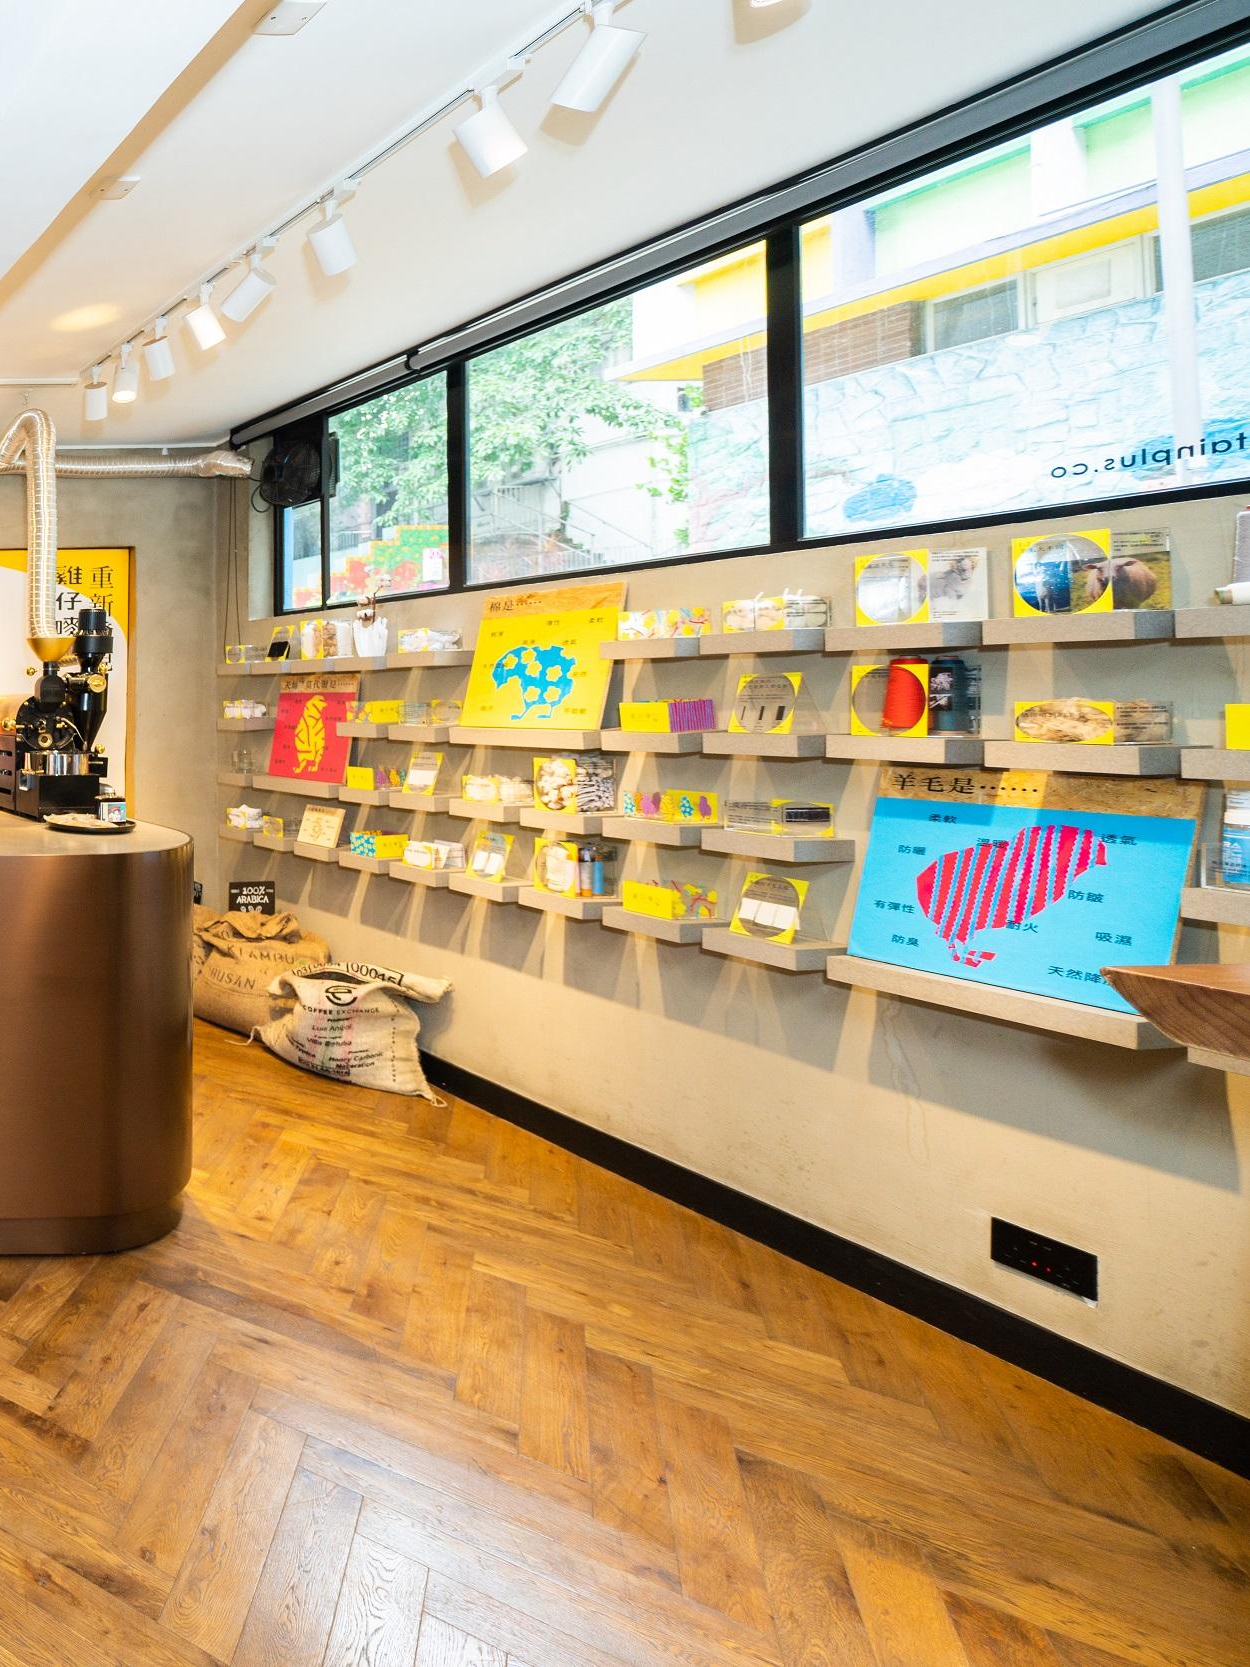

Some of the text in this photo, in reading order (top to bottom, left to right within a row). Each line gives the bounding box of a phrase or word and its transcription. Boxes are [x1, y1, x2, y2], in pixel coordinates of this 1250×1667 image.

[928, 813, 957, 824] 柔軟
[1101, 833, 1138, 846] 透氣
[242, 886, 266, 895] 100%
[236, 895, 269, 904] ARABICA
[874, 900, 915, 914] 有彈性
[1007, 920, 1038, 933] 耐火
[891, 934, 919, 947] 防臭
[1047, 965, 1107, 984] 天然降
[302, 1005, 380, 1015] COFFEE EXCHANGE
